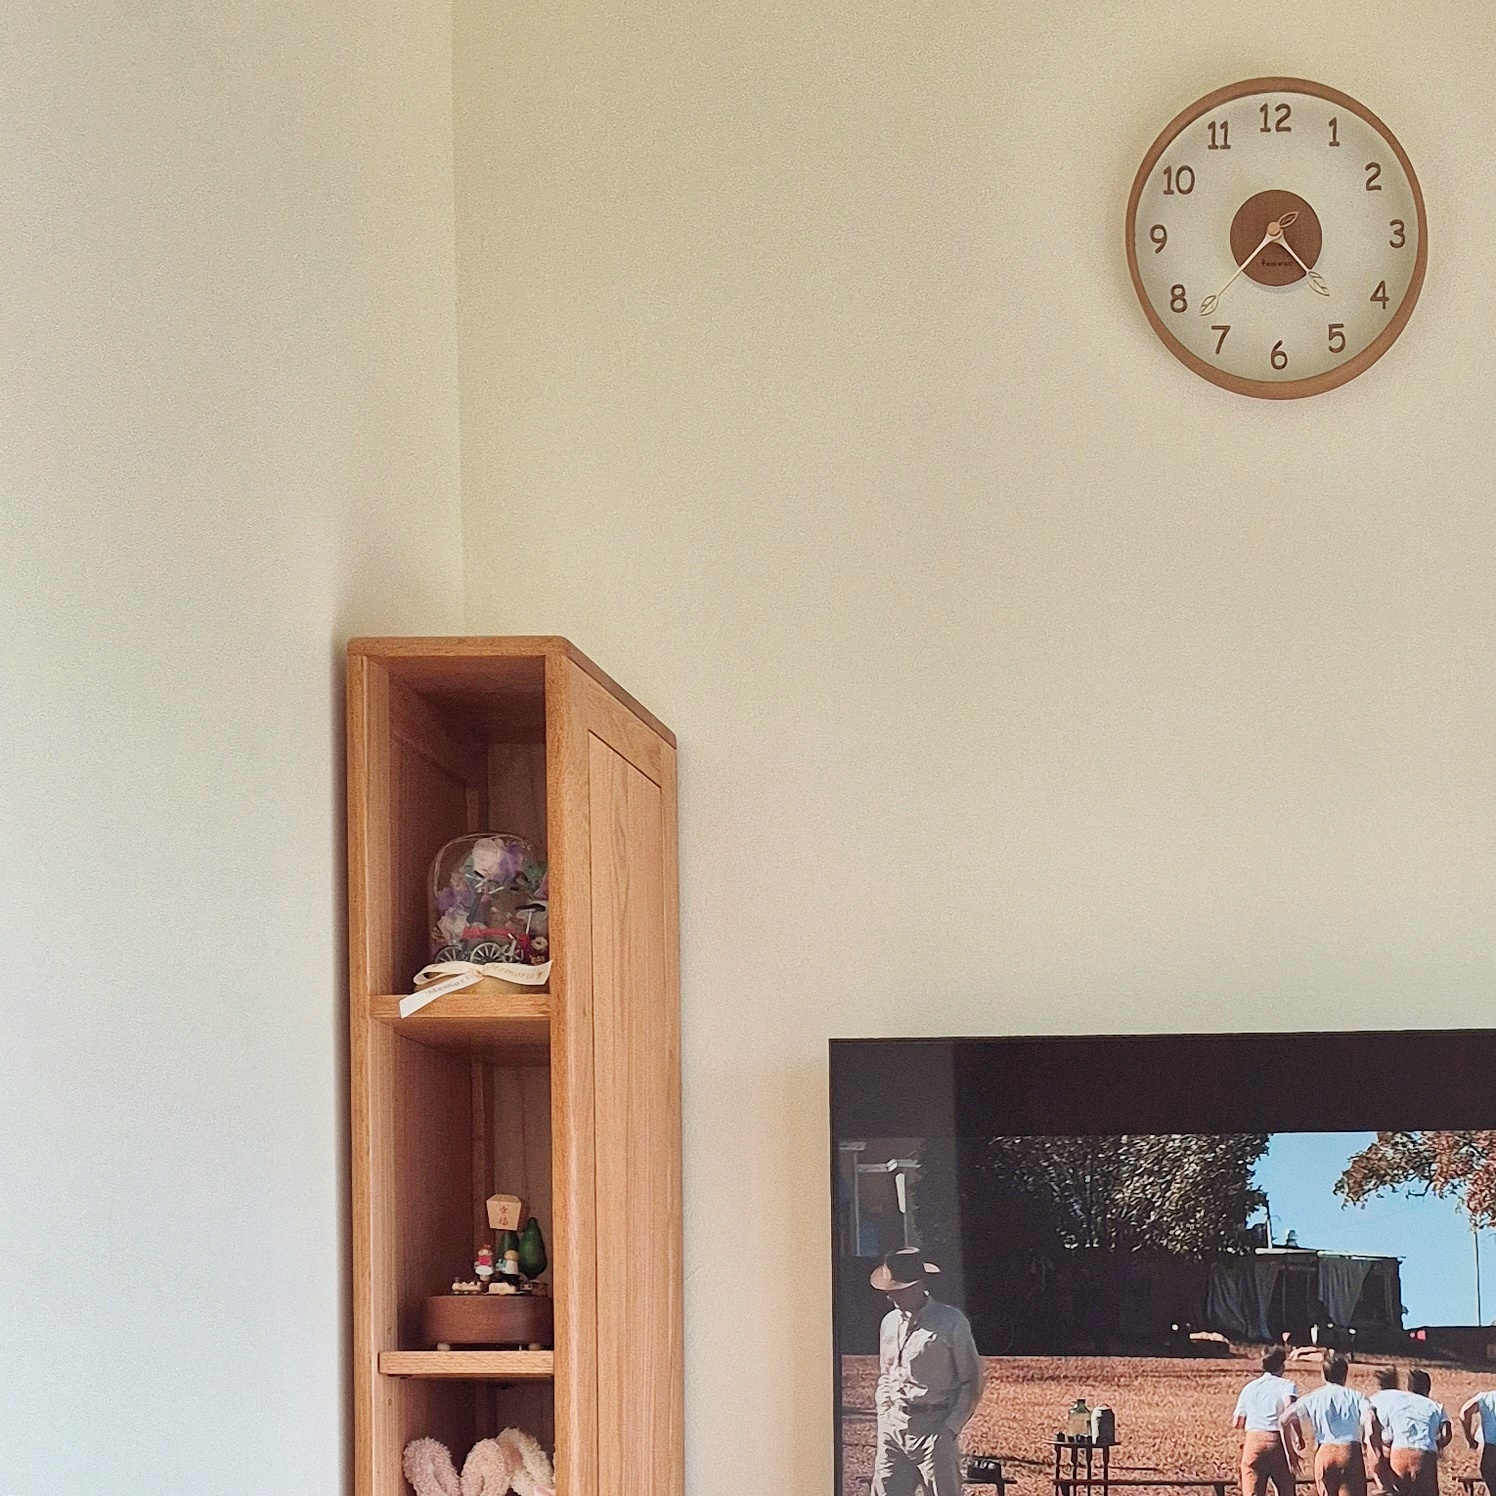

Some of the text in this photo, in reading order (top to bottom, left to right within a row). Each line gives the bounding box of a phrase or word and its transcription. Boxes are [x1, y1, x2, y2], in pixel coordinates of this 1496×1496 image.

[1259, 103, 1292, 132] 12
[1328, 117, 1340, 147] 1
[1207, 120, 1231, 150] 11
[1162, 165, 1196, 195] 10
[1364, 162, 1383, 191] 2
[1150, 224, 1168, 254] 9
[1389, 219, 1406, 249] 3
[1169, 284, 1188, 313] 8
[1369, 280, 1389, 310] 4
[1211, 325, 1231, 354] 7
[1327, 323, 1346, 353] 5
[1270, 340, 1288, 370] 6
